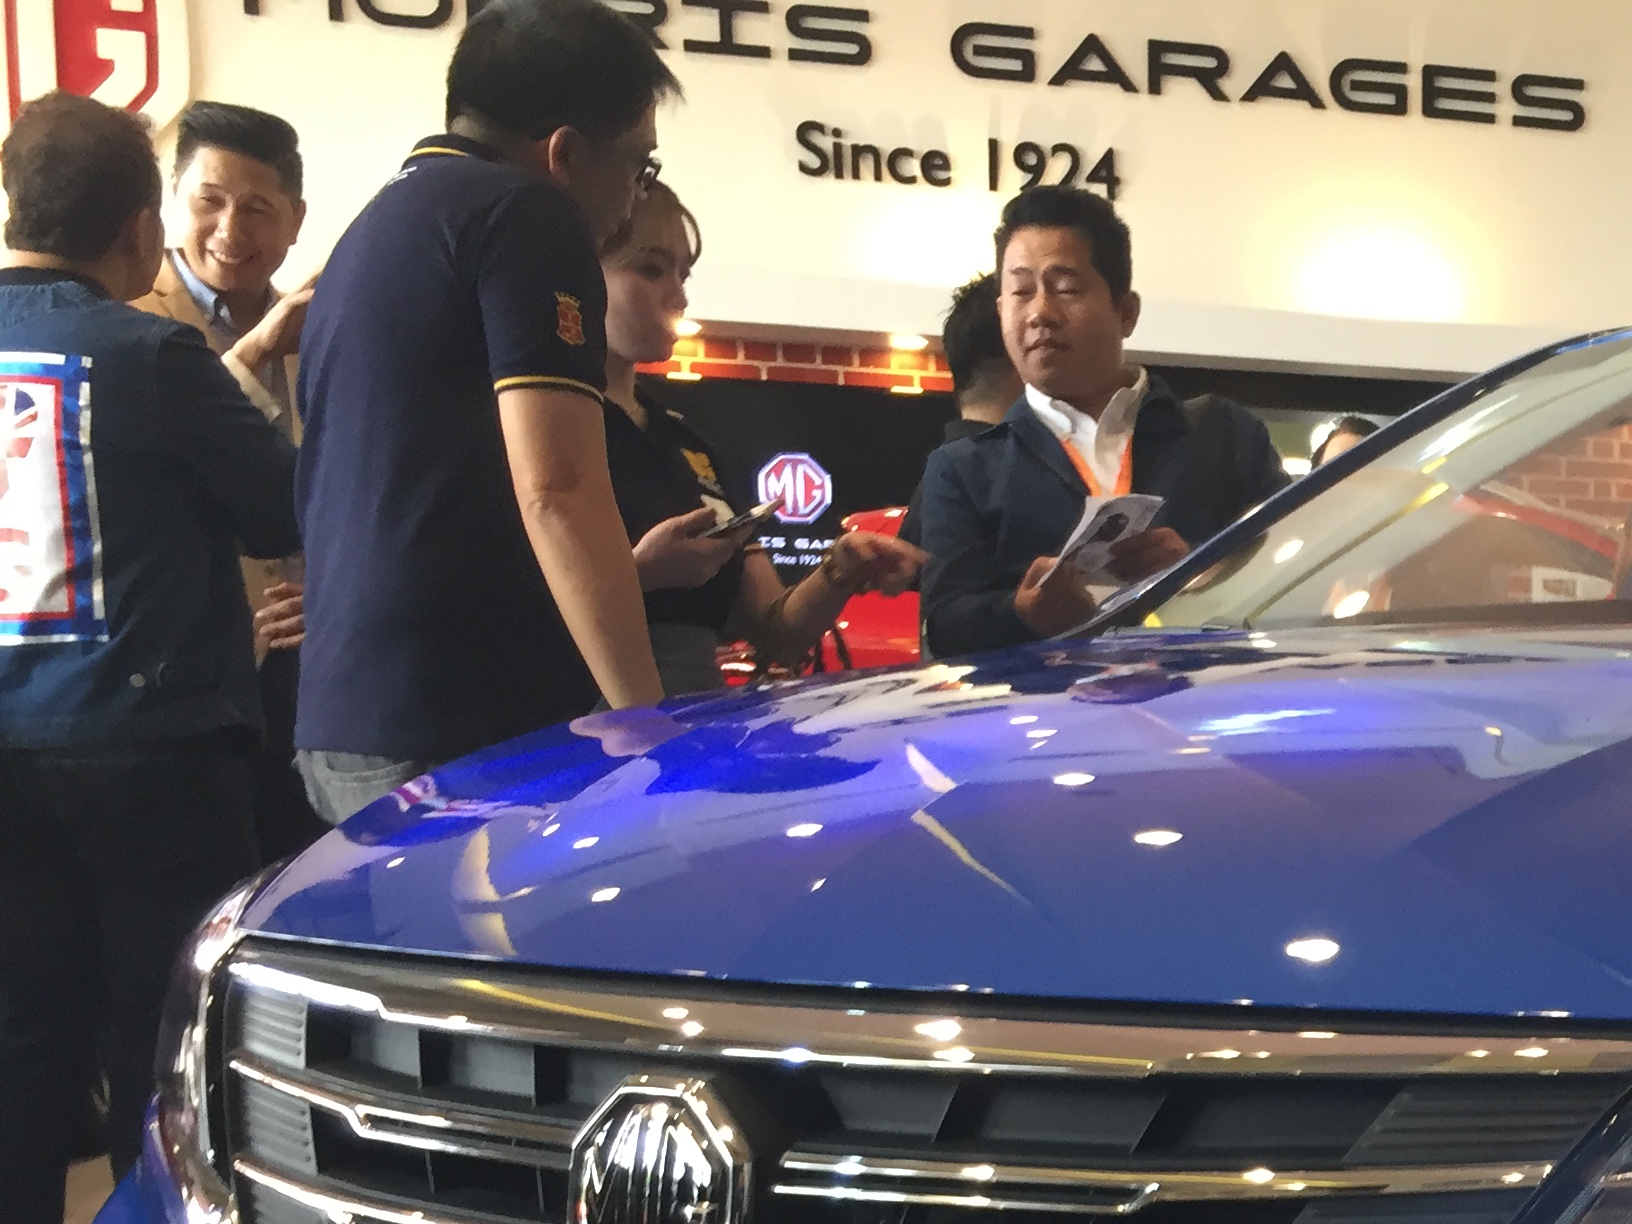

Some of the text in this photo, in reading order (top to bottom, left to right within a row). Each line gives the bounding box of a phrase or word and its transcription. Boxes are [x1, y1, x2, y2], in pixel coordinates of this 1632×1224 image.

[950, 21, 1586, 132] GARAGES
[796, 120, 1122, 201] Since 1924
[766, 461, 825, 516] MG
